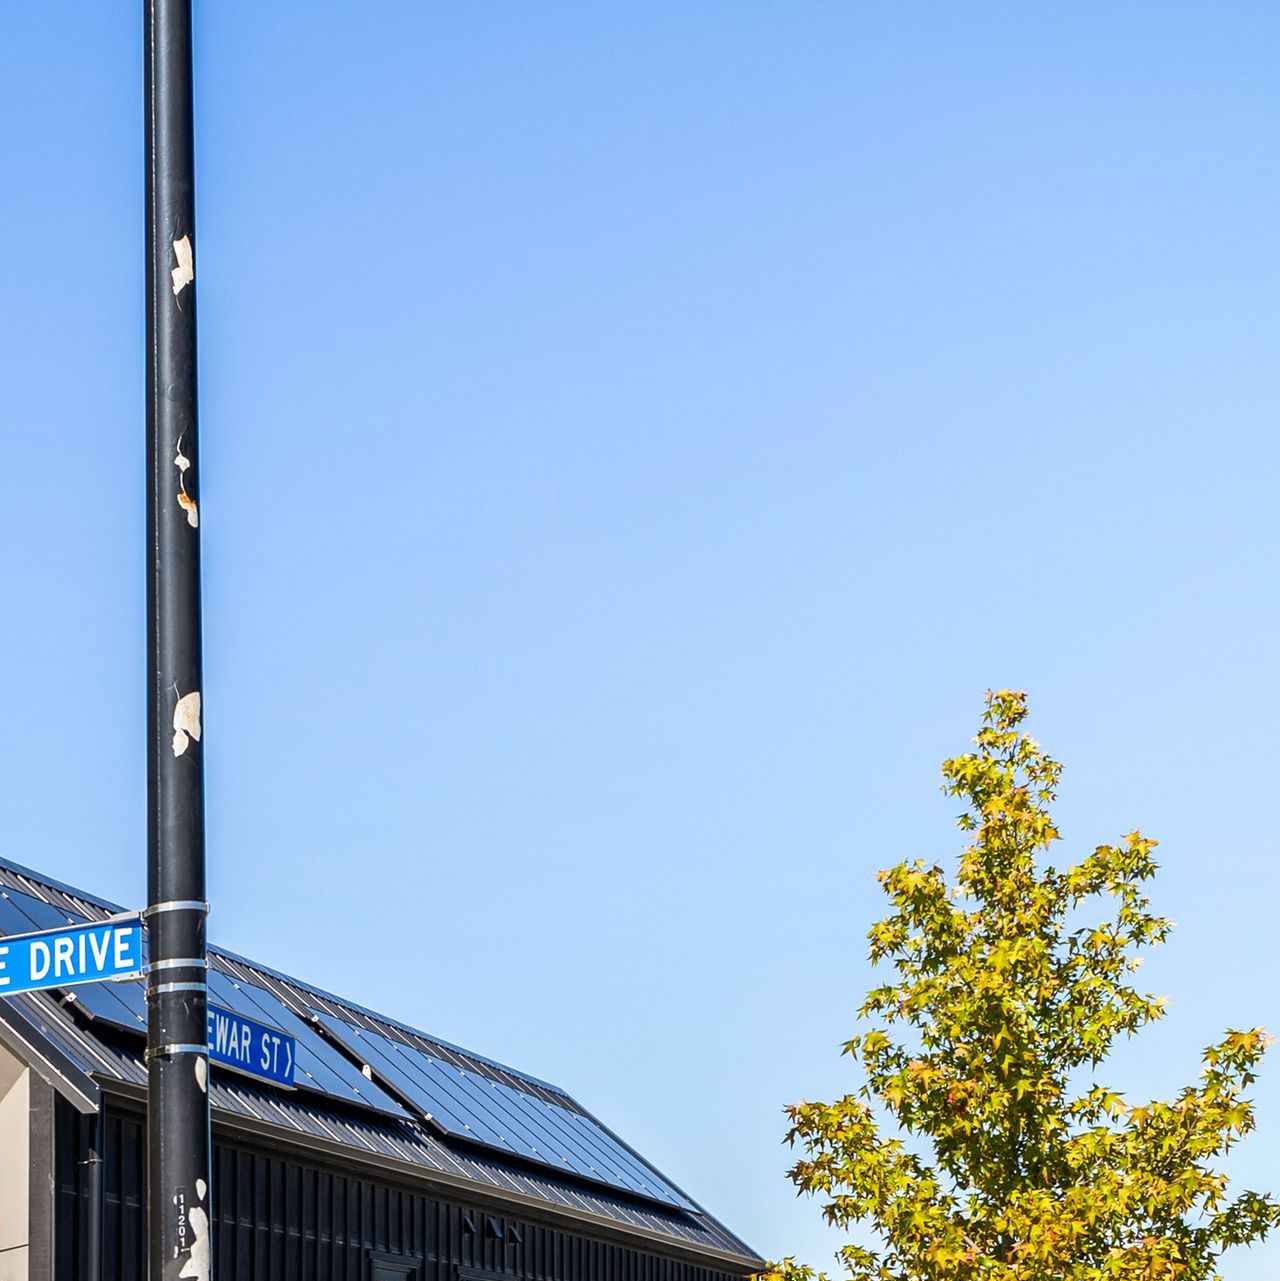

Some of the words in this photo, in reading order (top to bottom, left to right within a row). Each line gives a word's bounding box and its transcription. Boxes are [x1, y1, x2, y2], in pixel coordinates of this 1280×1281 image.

[29, 927, 134, 981] DRIVE
[260, 1032, 281, 1074] ST
[178, 1193, 186, 1247] 11201
